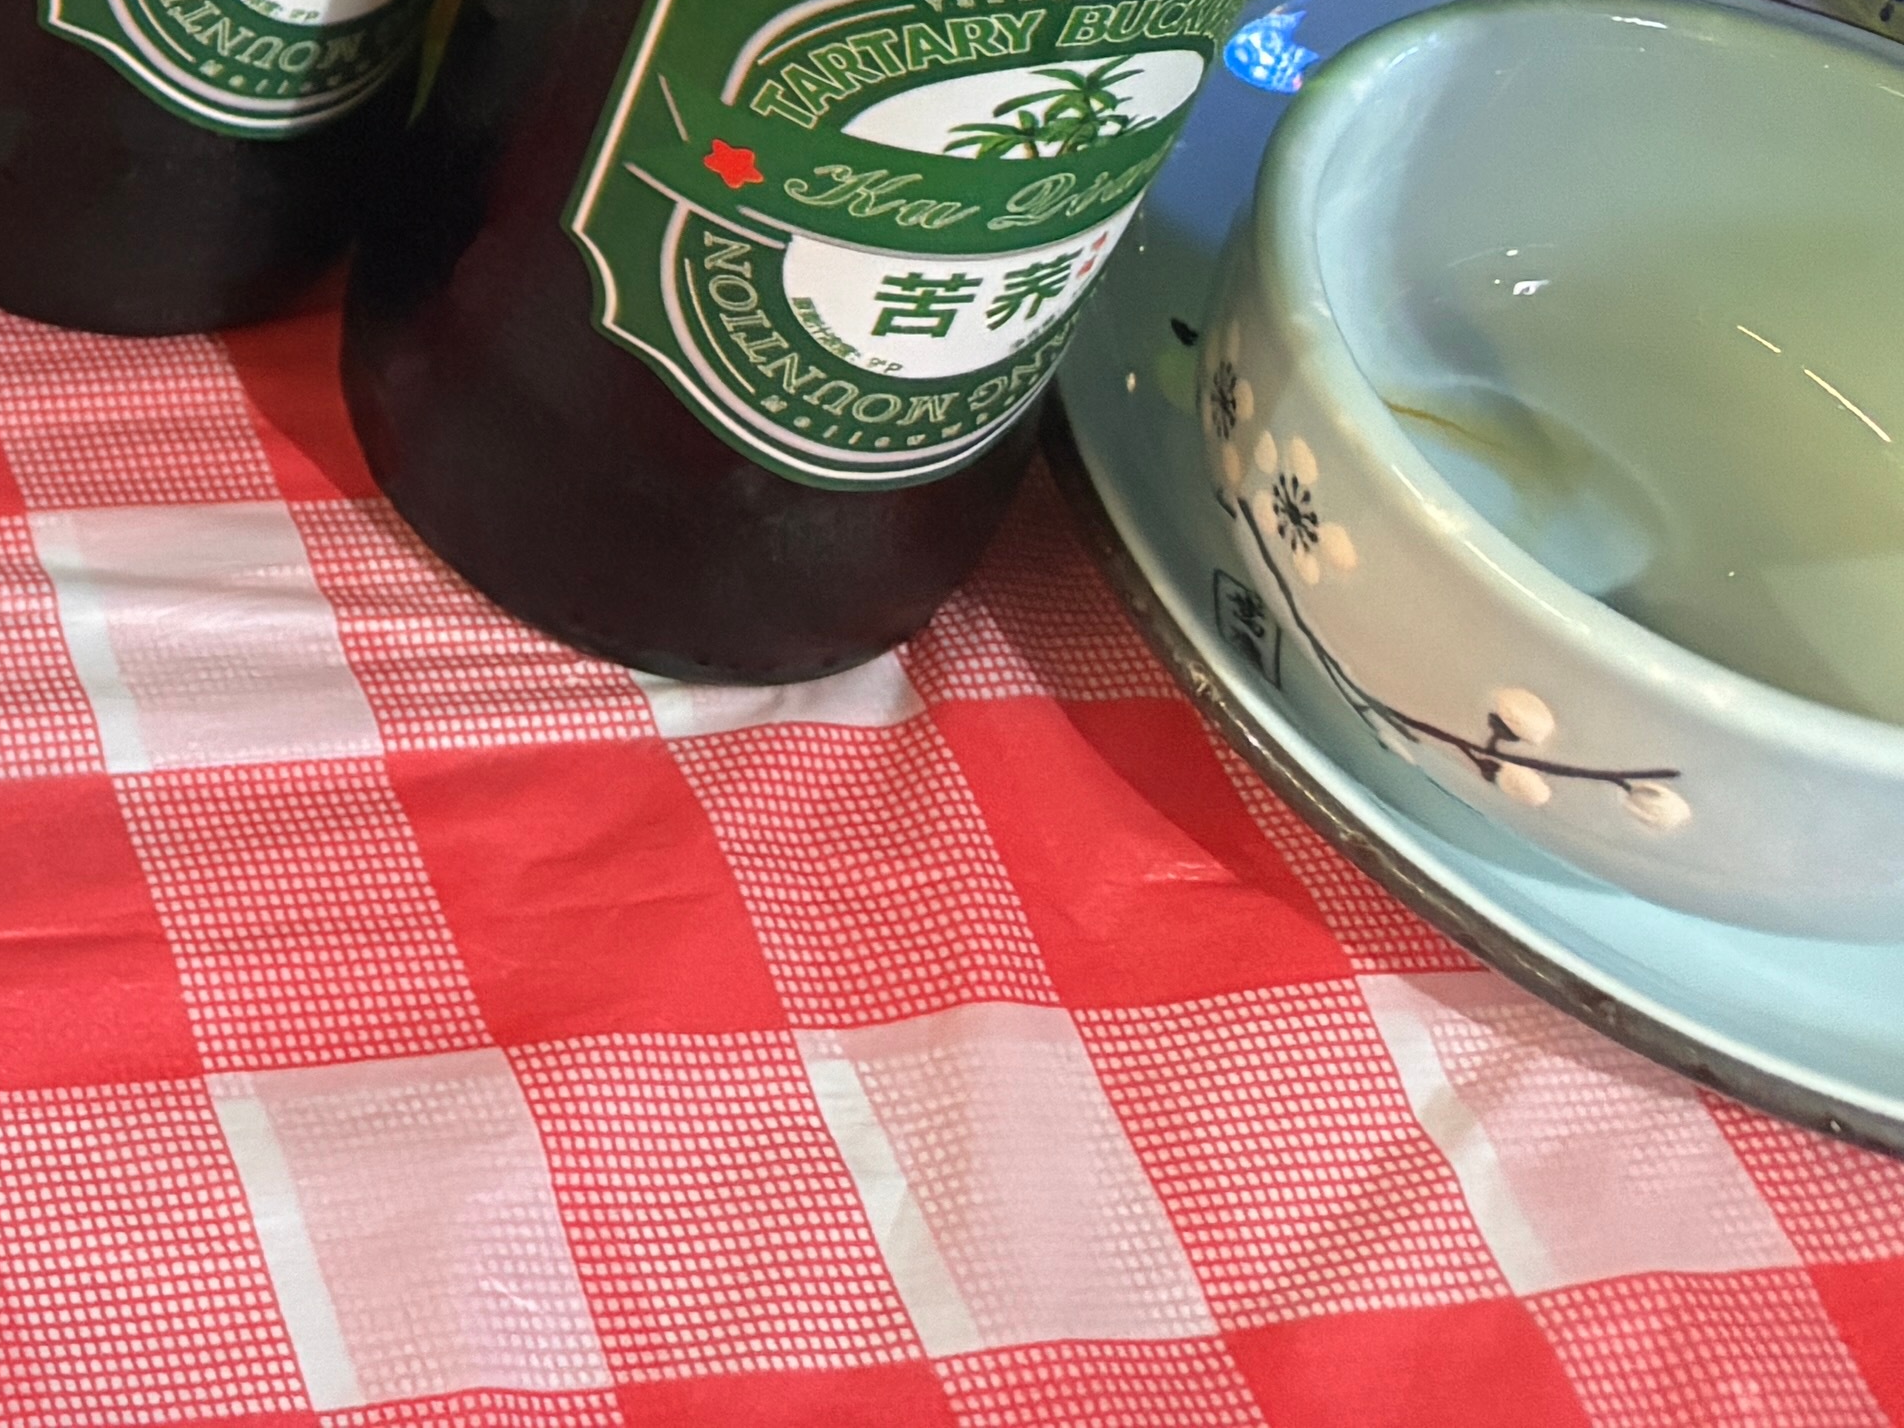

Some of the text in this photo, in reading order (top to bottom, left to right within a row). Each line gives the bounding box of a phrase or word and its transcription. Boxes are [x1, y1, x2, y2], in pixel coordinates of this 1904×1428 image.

[749, 8, 1047, 130] TARTARY
[701, 230, 958, 427] MOUNTION
[871, 247, 1074, 339] 苦荞
